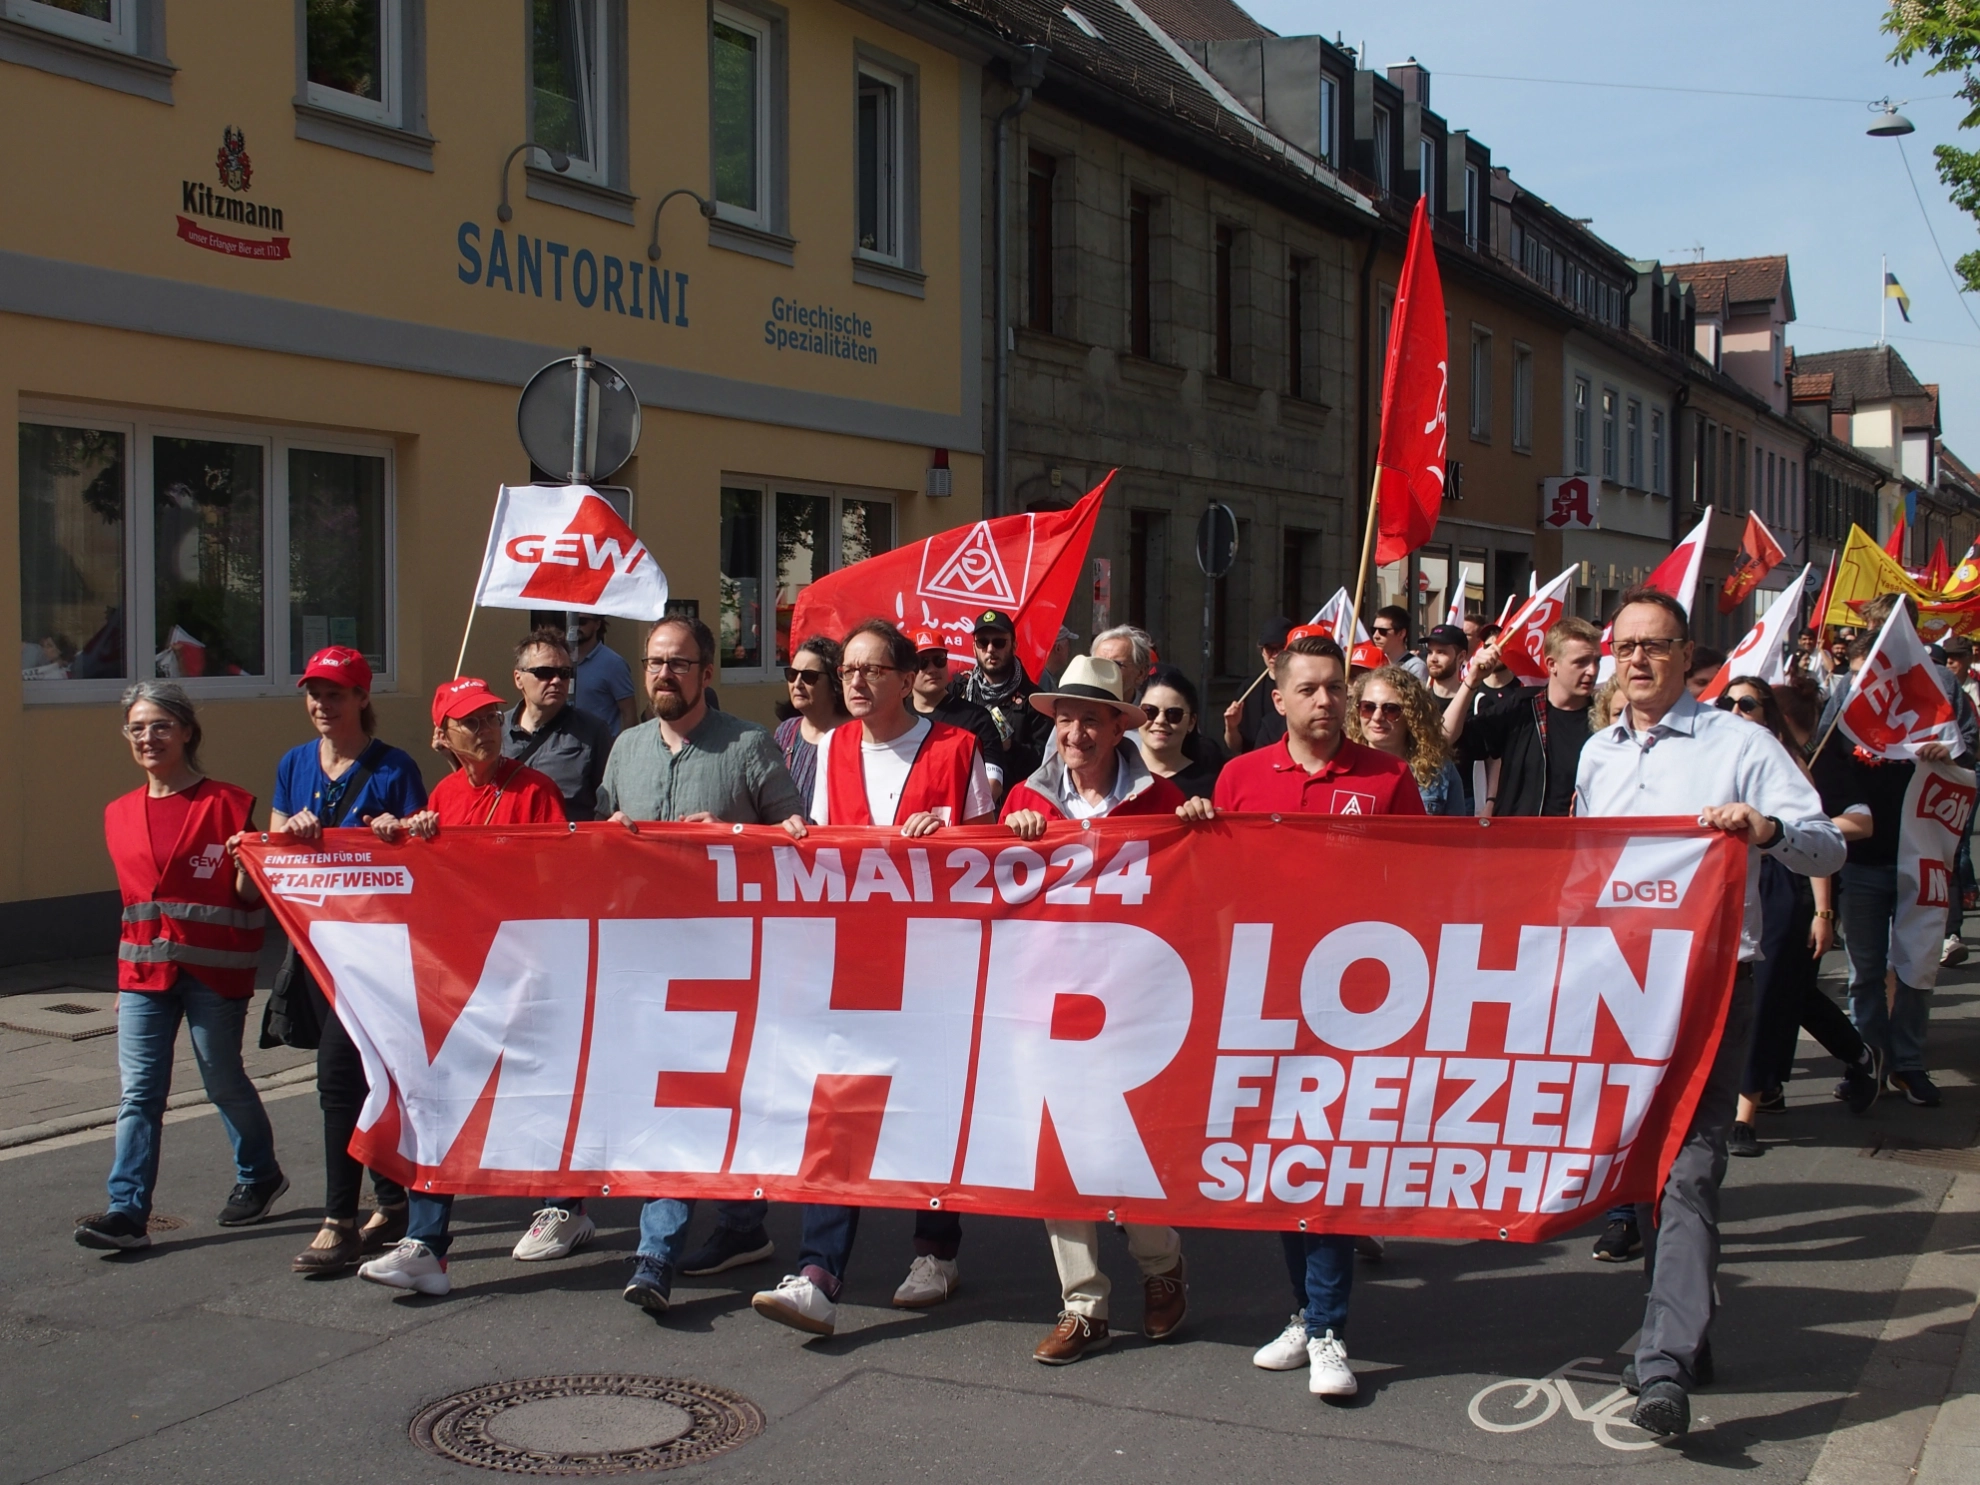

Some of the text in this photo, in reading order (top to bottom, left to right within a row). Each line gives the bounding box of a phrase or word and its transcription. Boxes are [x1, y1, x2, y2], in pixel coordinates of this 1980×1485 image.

[182, 180, 284, 232] Kitzmann
[188, 231, 281, 257] unser Erlanger Bier seit 1712
[457, 221, 689, 328] SANTORINI
[771, 296, 872, 339] Griechische
[764, 320, 878, 365] Spezialitäten
[505, 533, 648, 575] GEW
[189, 856, 224, 869] GEW
[264, 850, 372, 865] EINTRETEN FÜR DIE
[267, 871, 405, 888] #TARIFWENDE
[707, 840, 1152, 905] 1. MAI 2024
[1611, 879, 1678, 903] DGB
[1217, 920, 1695, 1061] LOHN
[308, 916, 1194, 1199] MEHR
[1204, 1055, 1670, 1149] FREIZEIT
